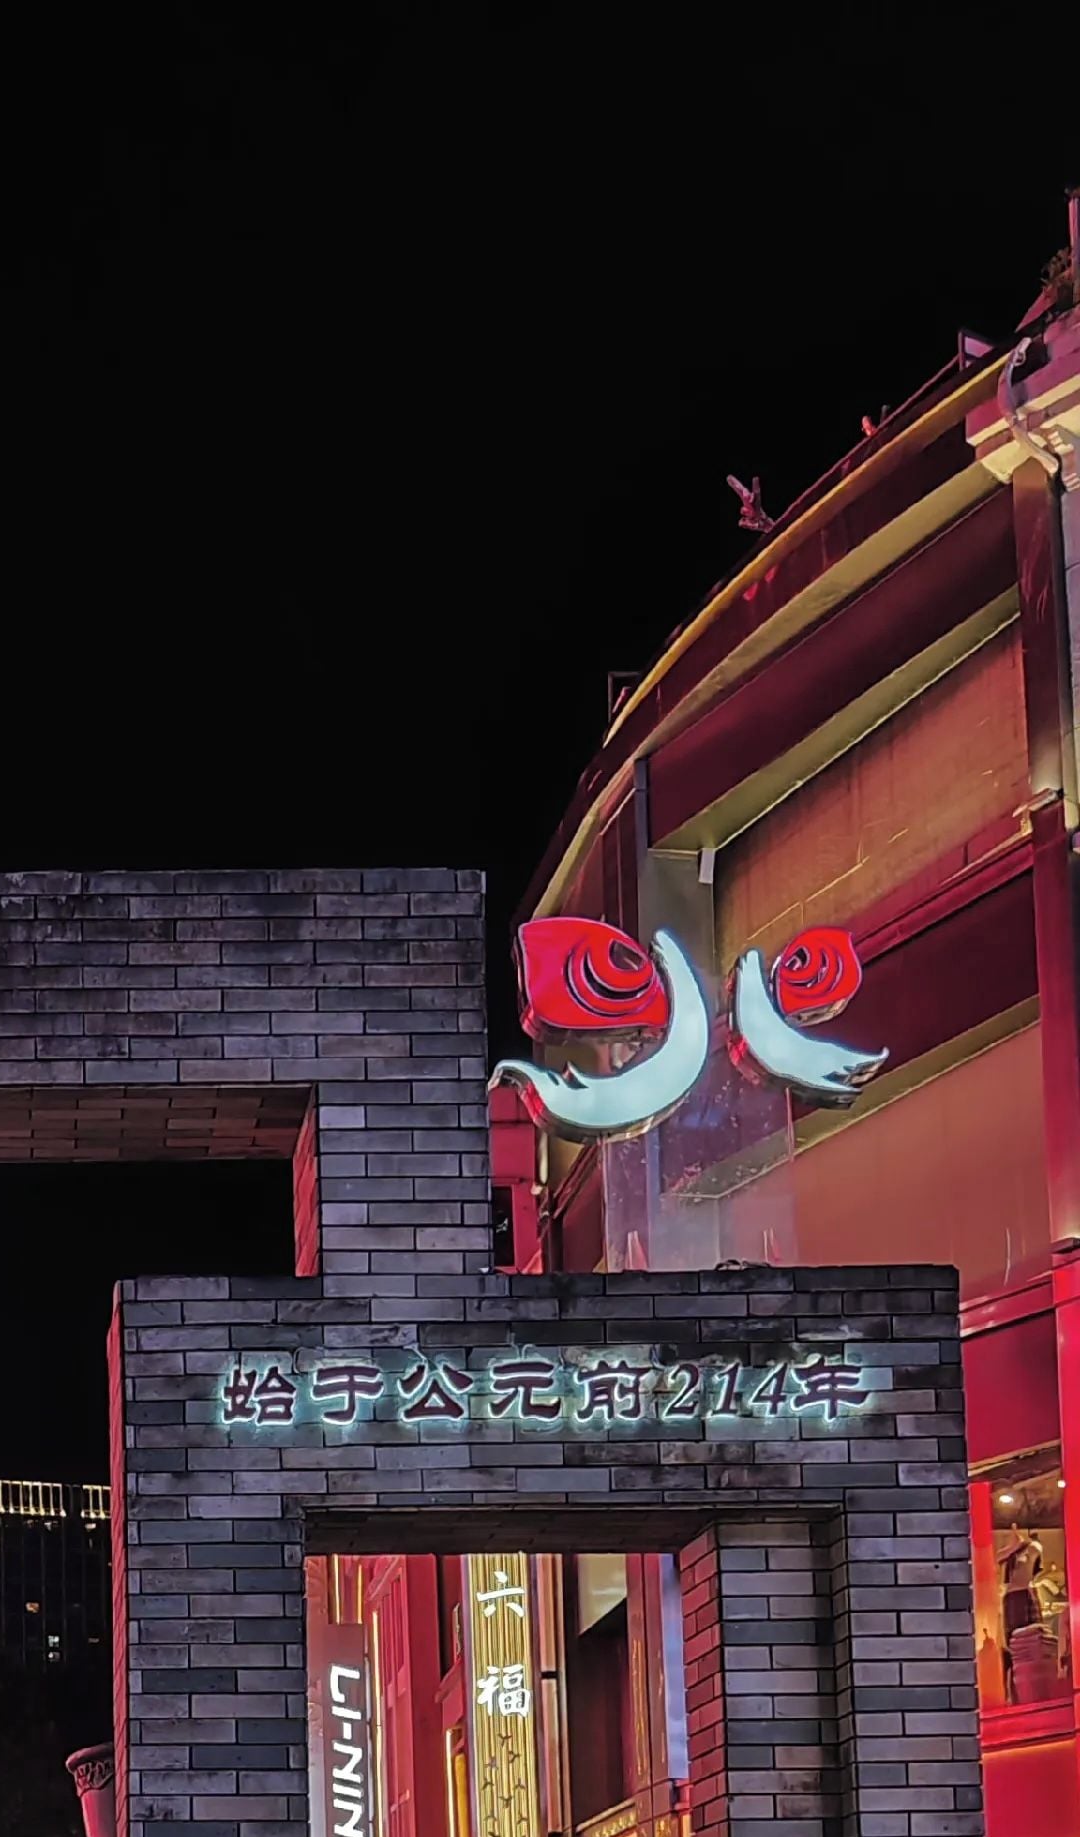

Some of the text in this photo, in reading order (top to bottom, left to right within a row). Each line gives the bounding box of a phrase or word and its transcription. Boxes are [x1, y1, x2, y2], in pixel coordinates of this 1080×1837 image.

[220, 1360, 870, 1424] 始于公元前214年
[476, 1570, 531, 1718] 六福
